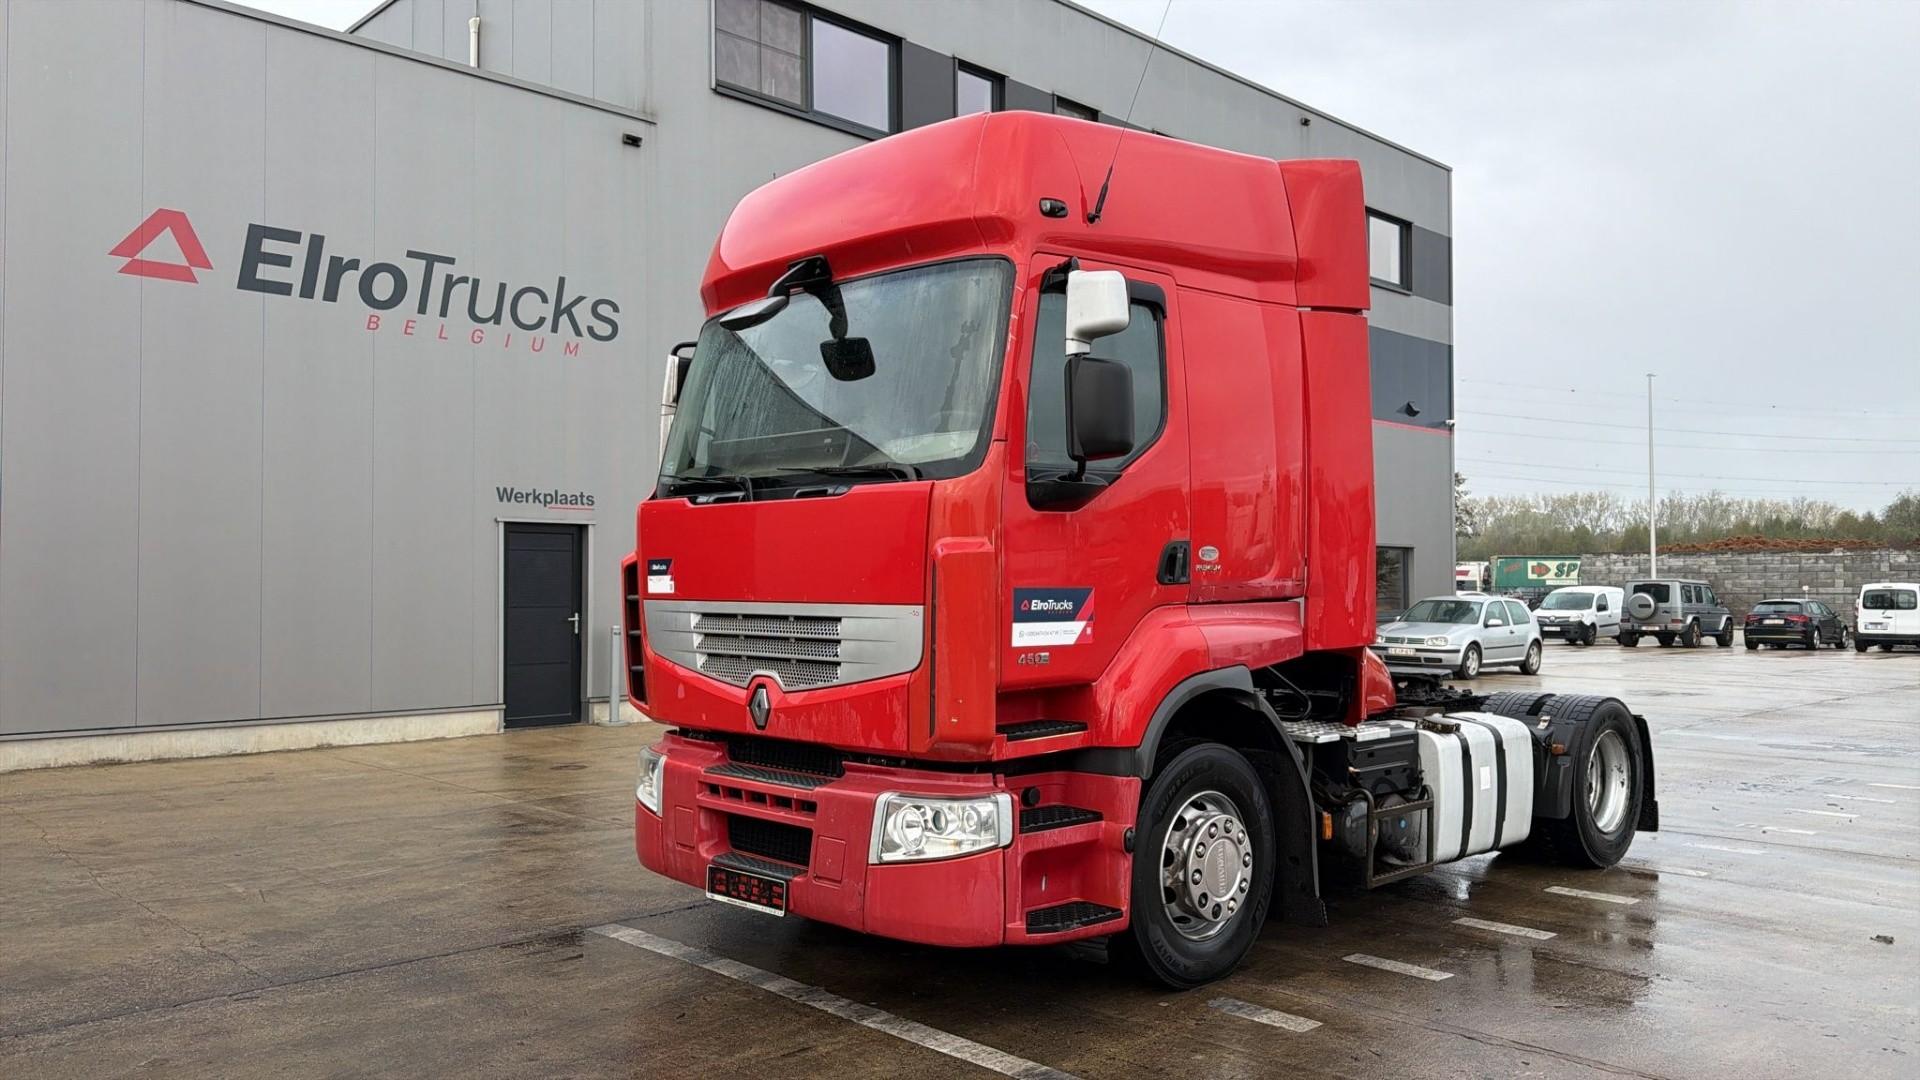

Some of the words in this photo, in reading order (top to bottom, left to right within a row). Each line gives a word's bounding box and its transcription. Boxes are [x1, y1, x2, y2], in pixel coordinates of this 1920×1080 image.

[236, 223, 620, 342] ElroTrucks
[366, 314, 580, 357] BELGIUM
[496, 486, 595, 508] Werkplaats
[1031, 599, 1073, 611] ElroTrucks
